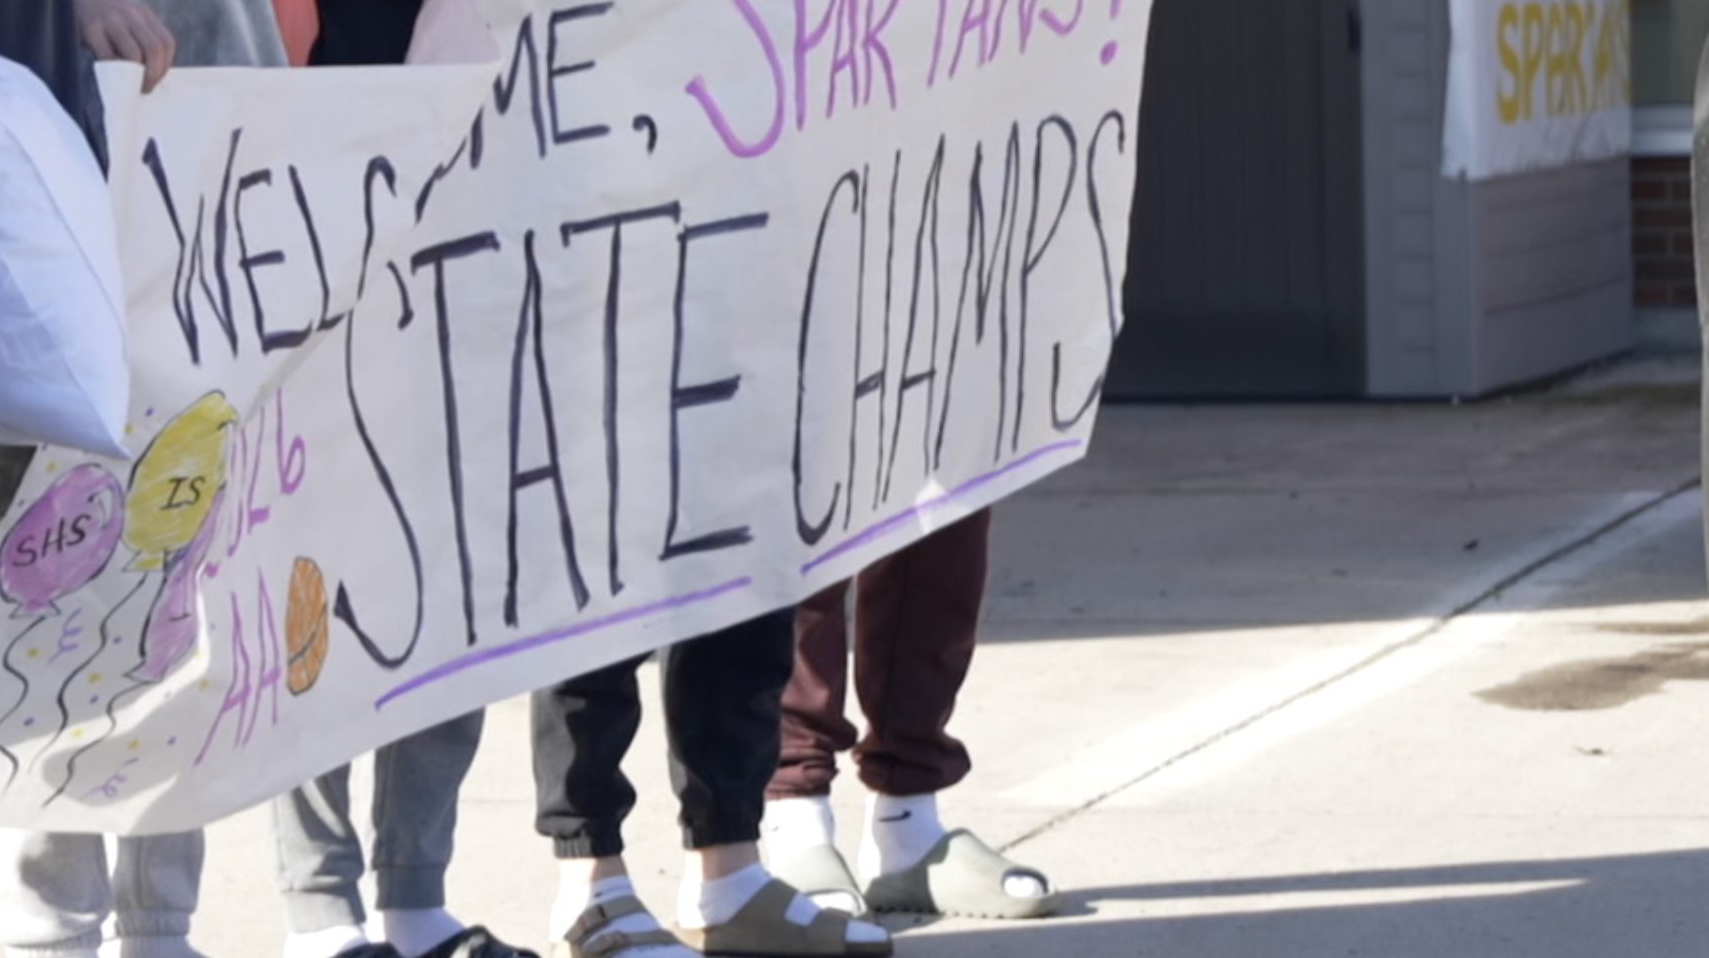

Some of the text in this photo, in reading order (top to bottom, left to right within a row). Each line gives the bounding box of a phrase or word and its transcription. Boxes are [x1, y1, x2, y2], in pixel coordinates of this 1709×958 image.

[334, 110, 1129, 669] STATE CHAMPS
[158, 475, 207, 512] IS
[11, 512, 93, 568] SHS
